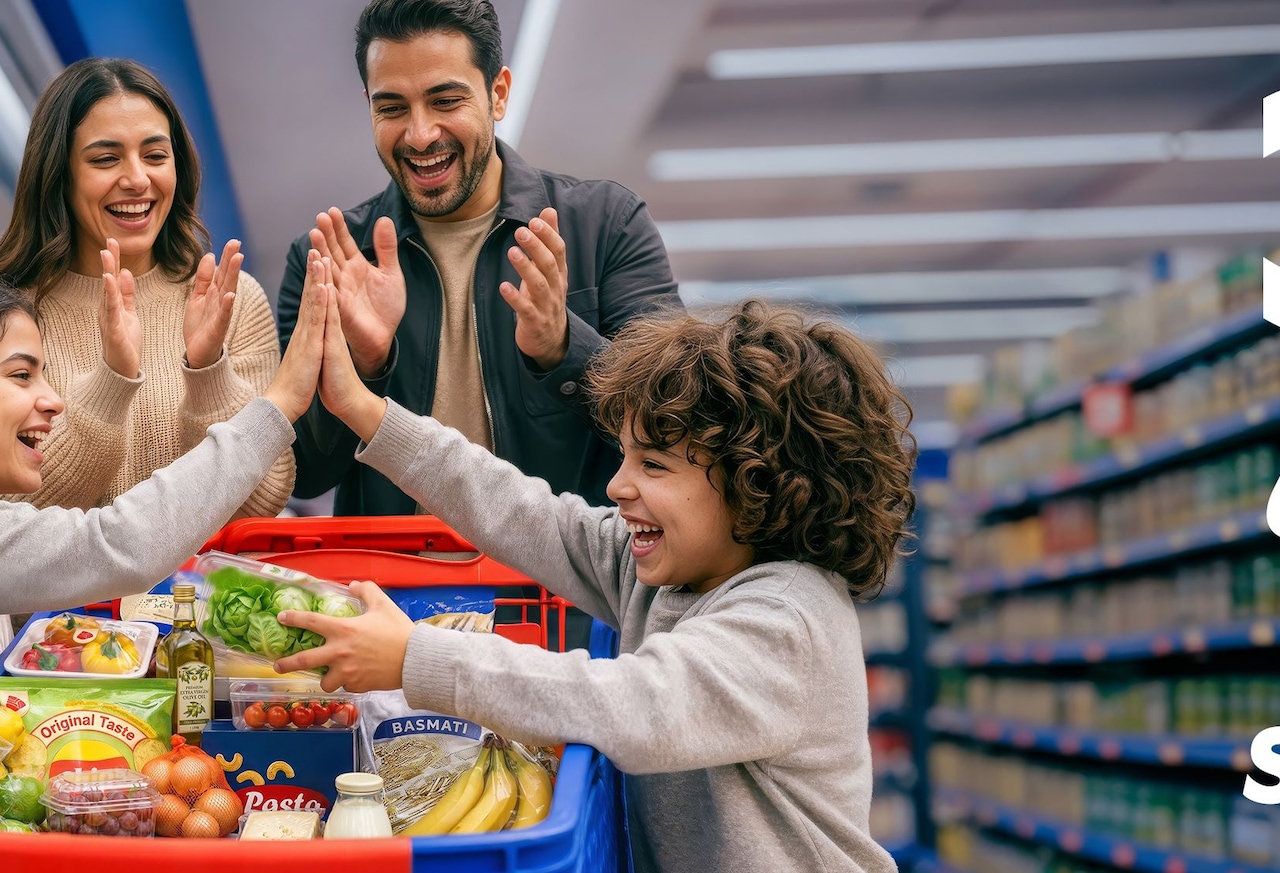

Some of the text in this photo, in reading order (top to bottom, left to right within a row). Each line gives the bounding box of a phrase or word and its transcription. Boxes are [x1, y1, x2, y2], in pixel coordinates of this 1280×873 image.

[40, 713, 135, 741] Original Taste
[391, 719, 468, 735] BASMATI
[243, 790, 322, 814] Pasta
